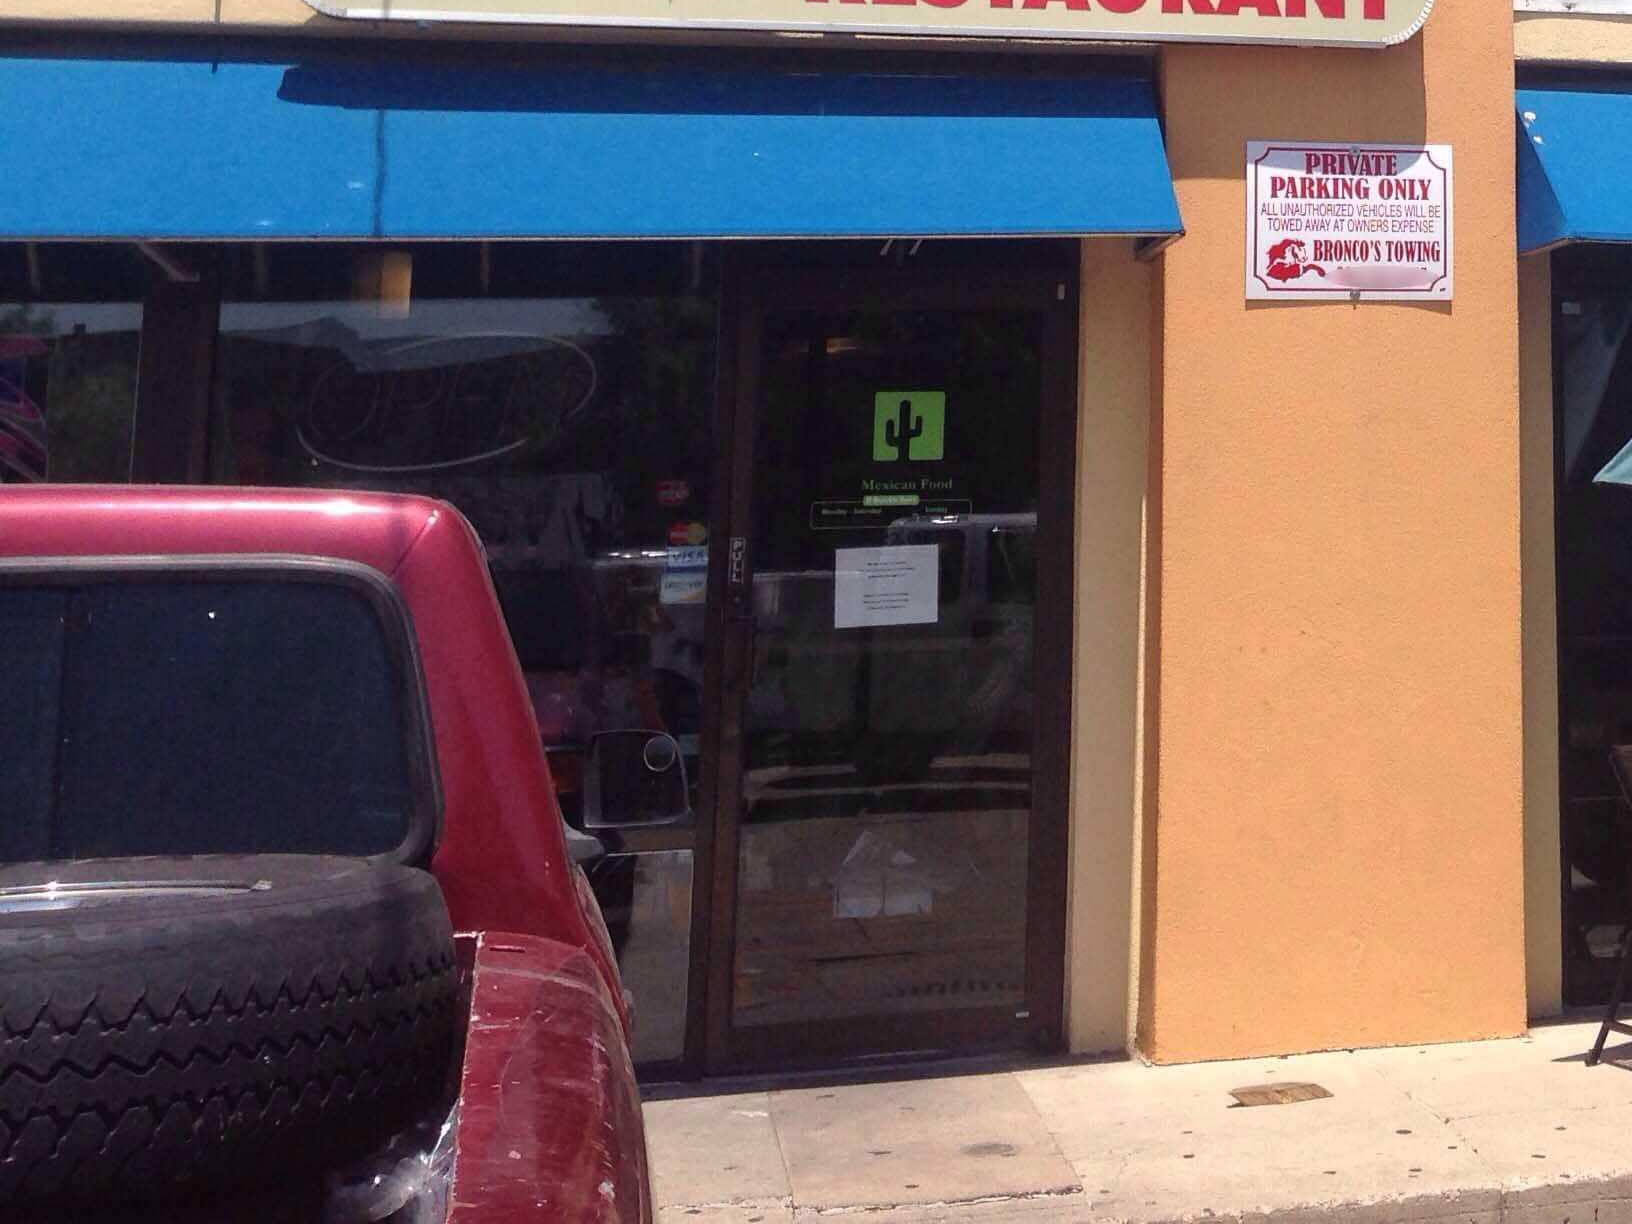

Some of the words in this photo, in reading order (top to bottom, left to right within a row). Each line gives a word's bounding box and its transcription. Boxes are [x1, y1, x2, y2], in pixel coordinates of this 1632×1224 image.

[1305, 153, 1397, 176] PRIVATE
[1270, 176, 1370, 200] PARKING
[1378, 178, 1431, 201] ONLY
[1261, 203, 1277, 216] ALL
[1280, 203, 1354, 217] UNAUTHORIZED
[1357, 204, 1402, 218] VEHICLES
[1405, 204, 1426, 218] WILL
[1428, 205, 1440, 218] BE
[1268, 218, 1302, 232] TOWED
[1305, 218, 1331, 232] AWAY
[1333, 219, 1344, 232] AT
[1347, 219, 1389, 233] OWNERS
[1391, 219, 1434, 233] EXPENSE
[1313, 239, 1382, 262] BRONCO'S
[1386, 240, 1440, 263] TOWING
[861, 479, 916, 490] Mexican
[921, 478, 952, 489] Food
